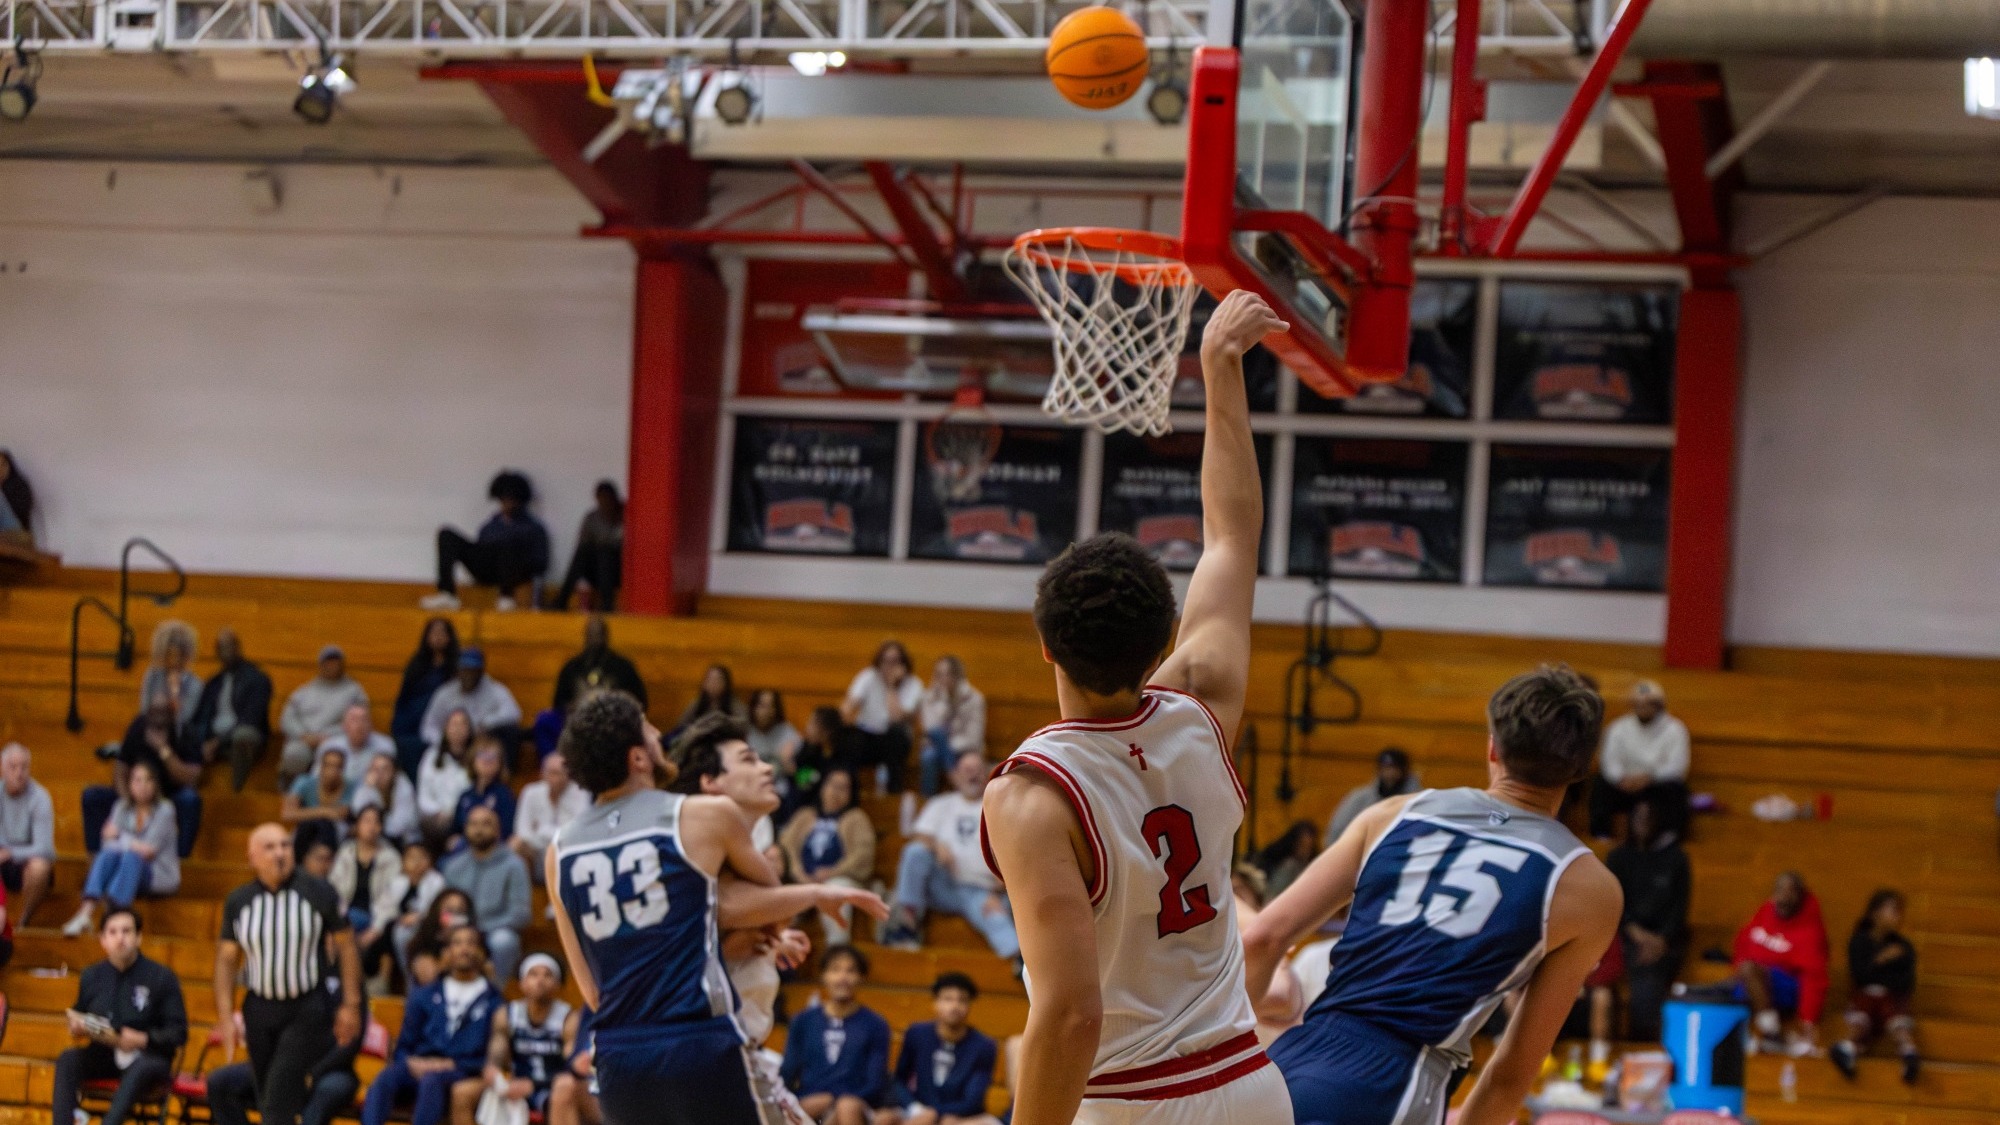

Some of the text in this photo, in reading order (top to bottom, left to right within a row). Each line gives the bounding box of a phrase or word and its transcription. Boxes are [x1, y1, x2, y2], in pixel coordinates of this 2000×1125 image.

[570, 839, 670, 942] 33
[1141, 803, 1218, 940] 2
[1378, 829, 1531, 939] 15
